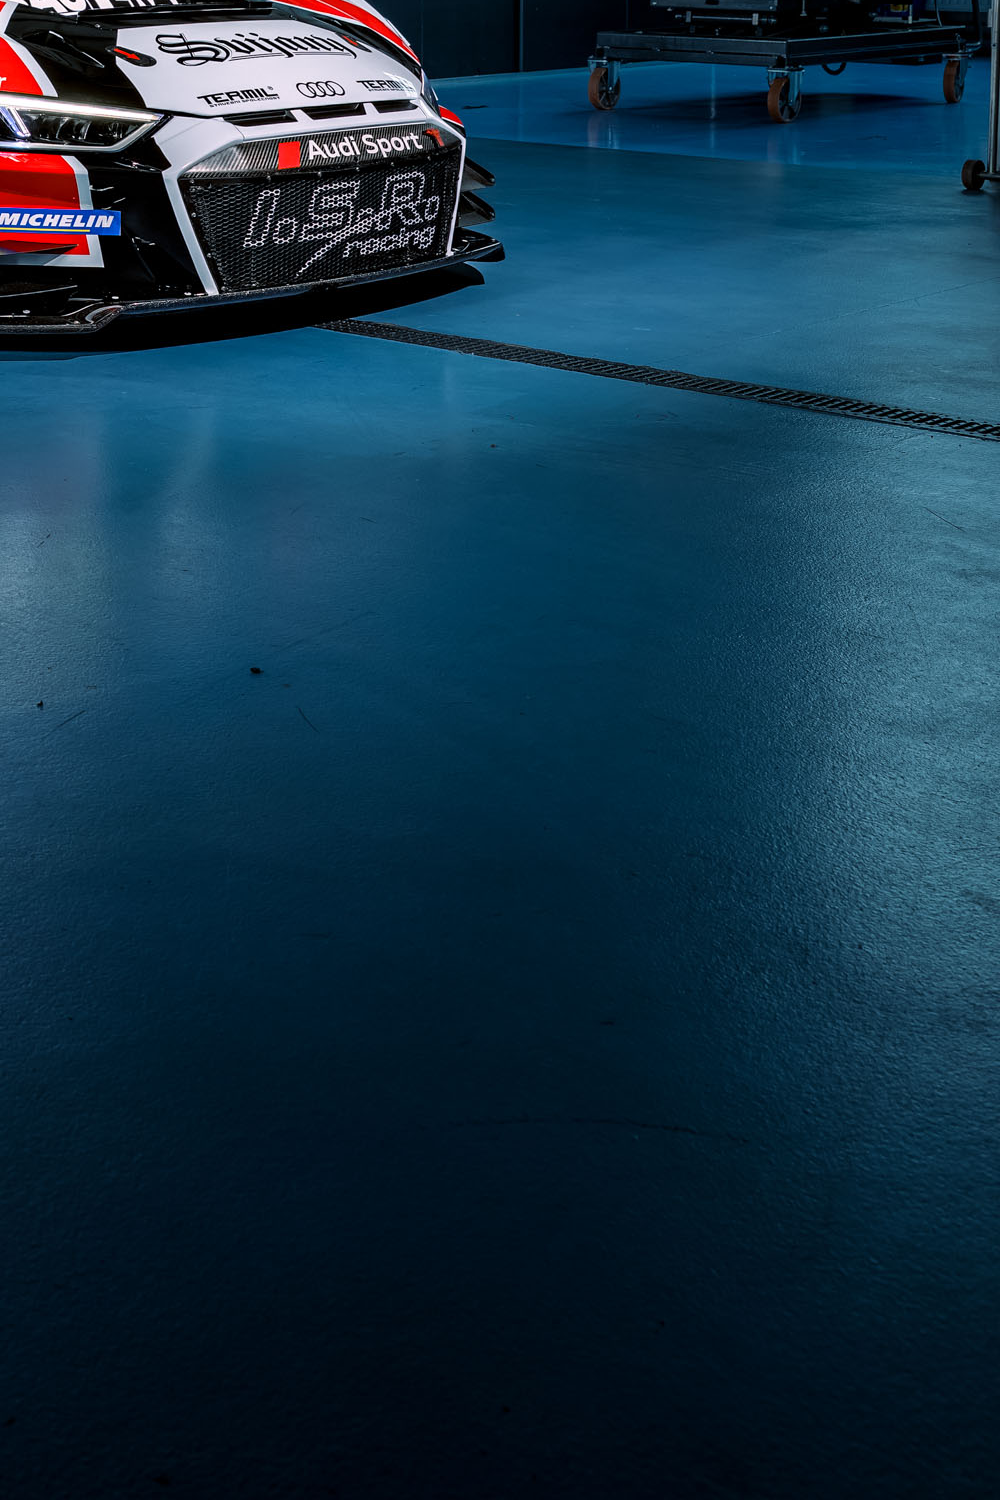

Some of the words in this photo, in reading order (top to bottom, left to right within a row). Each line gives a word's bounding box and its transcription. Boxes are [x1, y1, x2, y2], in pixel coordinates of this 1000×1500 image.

[156, 32, 357, 67] Svijany
[197, 88, 279, 105] TERMIL
[309, 137, 361, 160] Audi
[362, 132, 423, 158] Sport
[343, 226, 436, 258] racing
